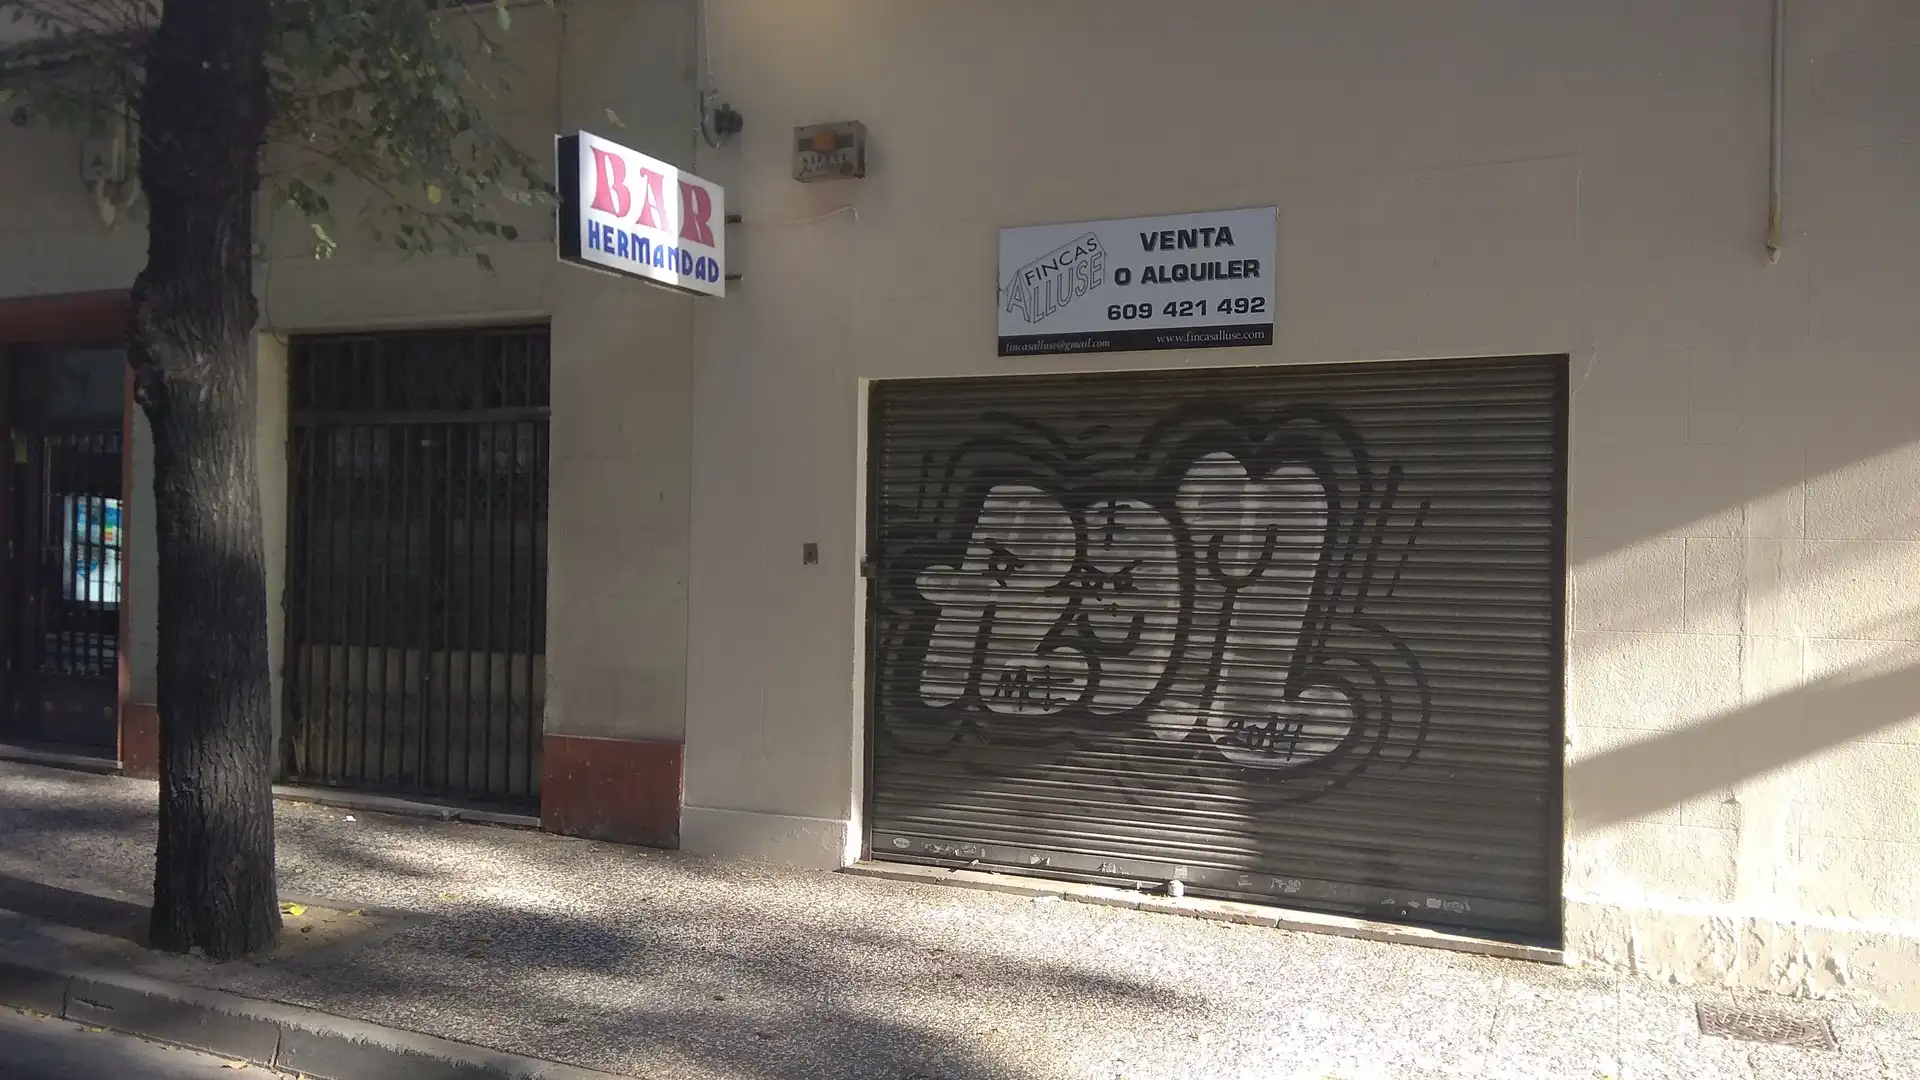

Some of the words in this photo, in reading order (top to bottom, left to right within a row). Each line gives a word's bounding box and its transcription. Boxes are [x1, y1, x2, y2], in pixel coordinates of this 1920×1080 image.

[590, 145, 715, 248] BAR
[588, 219, 720, 283] HERMANDAD
[1140, 226, 1235, 252] VENTA
[1025, 237, 1099, 287] FINCAS
[1113, 267, 1132, 287] O
[1141, 259, 1262, 285] ALQUILER
[1006, 251, 1103, 324] ALLUSE
[1107, 303, 1153, 321] 609
[1162, 299, 1208, 318] 421
[1217, 296, 1266, 315] 492
[1005, 337, 1111, 353] fincasalluse@gmail.com
[1156, 329, 1265, 343] www.fincasalluse.com
